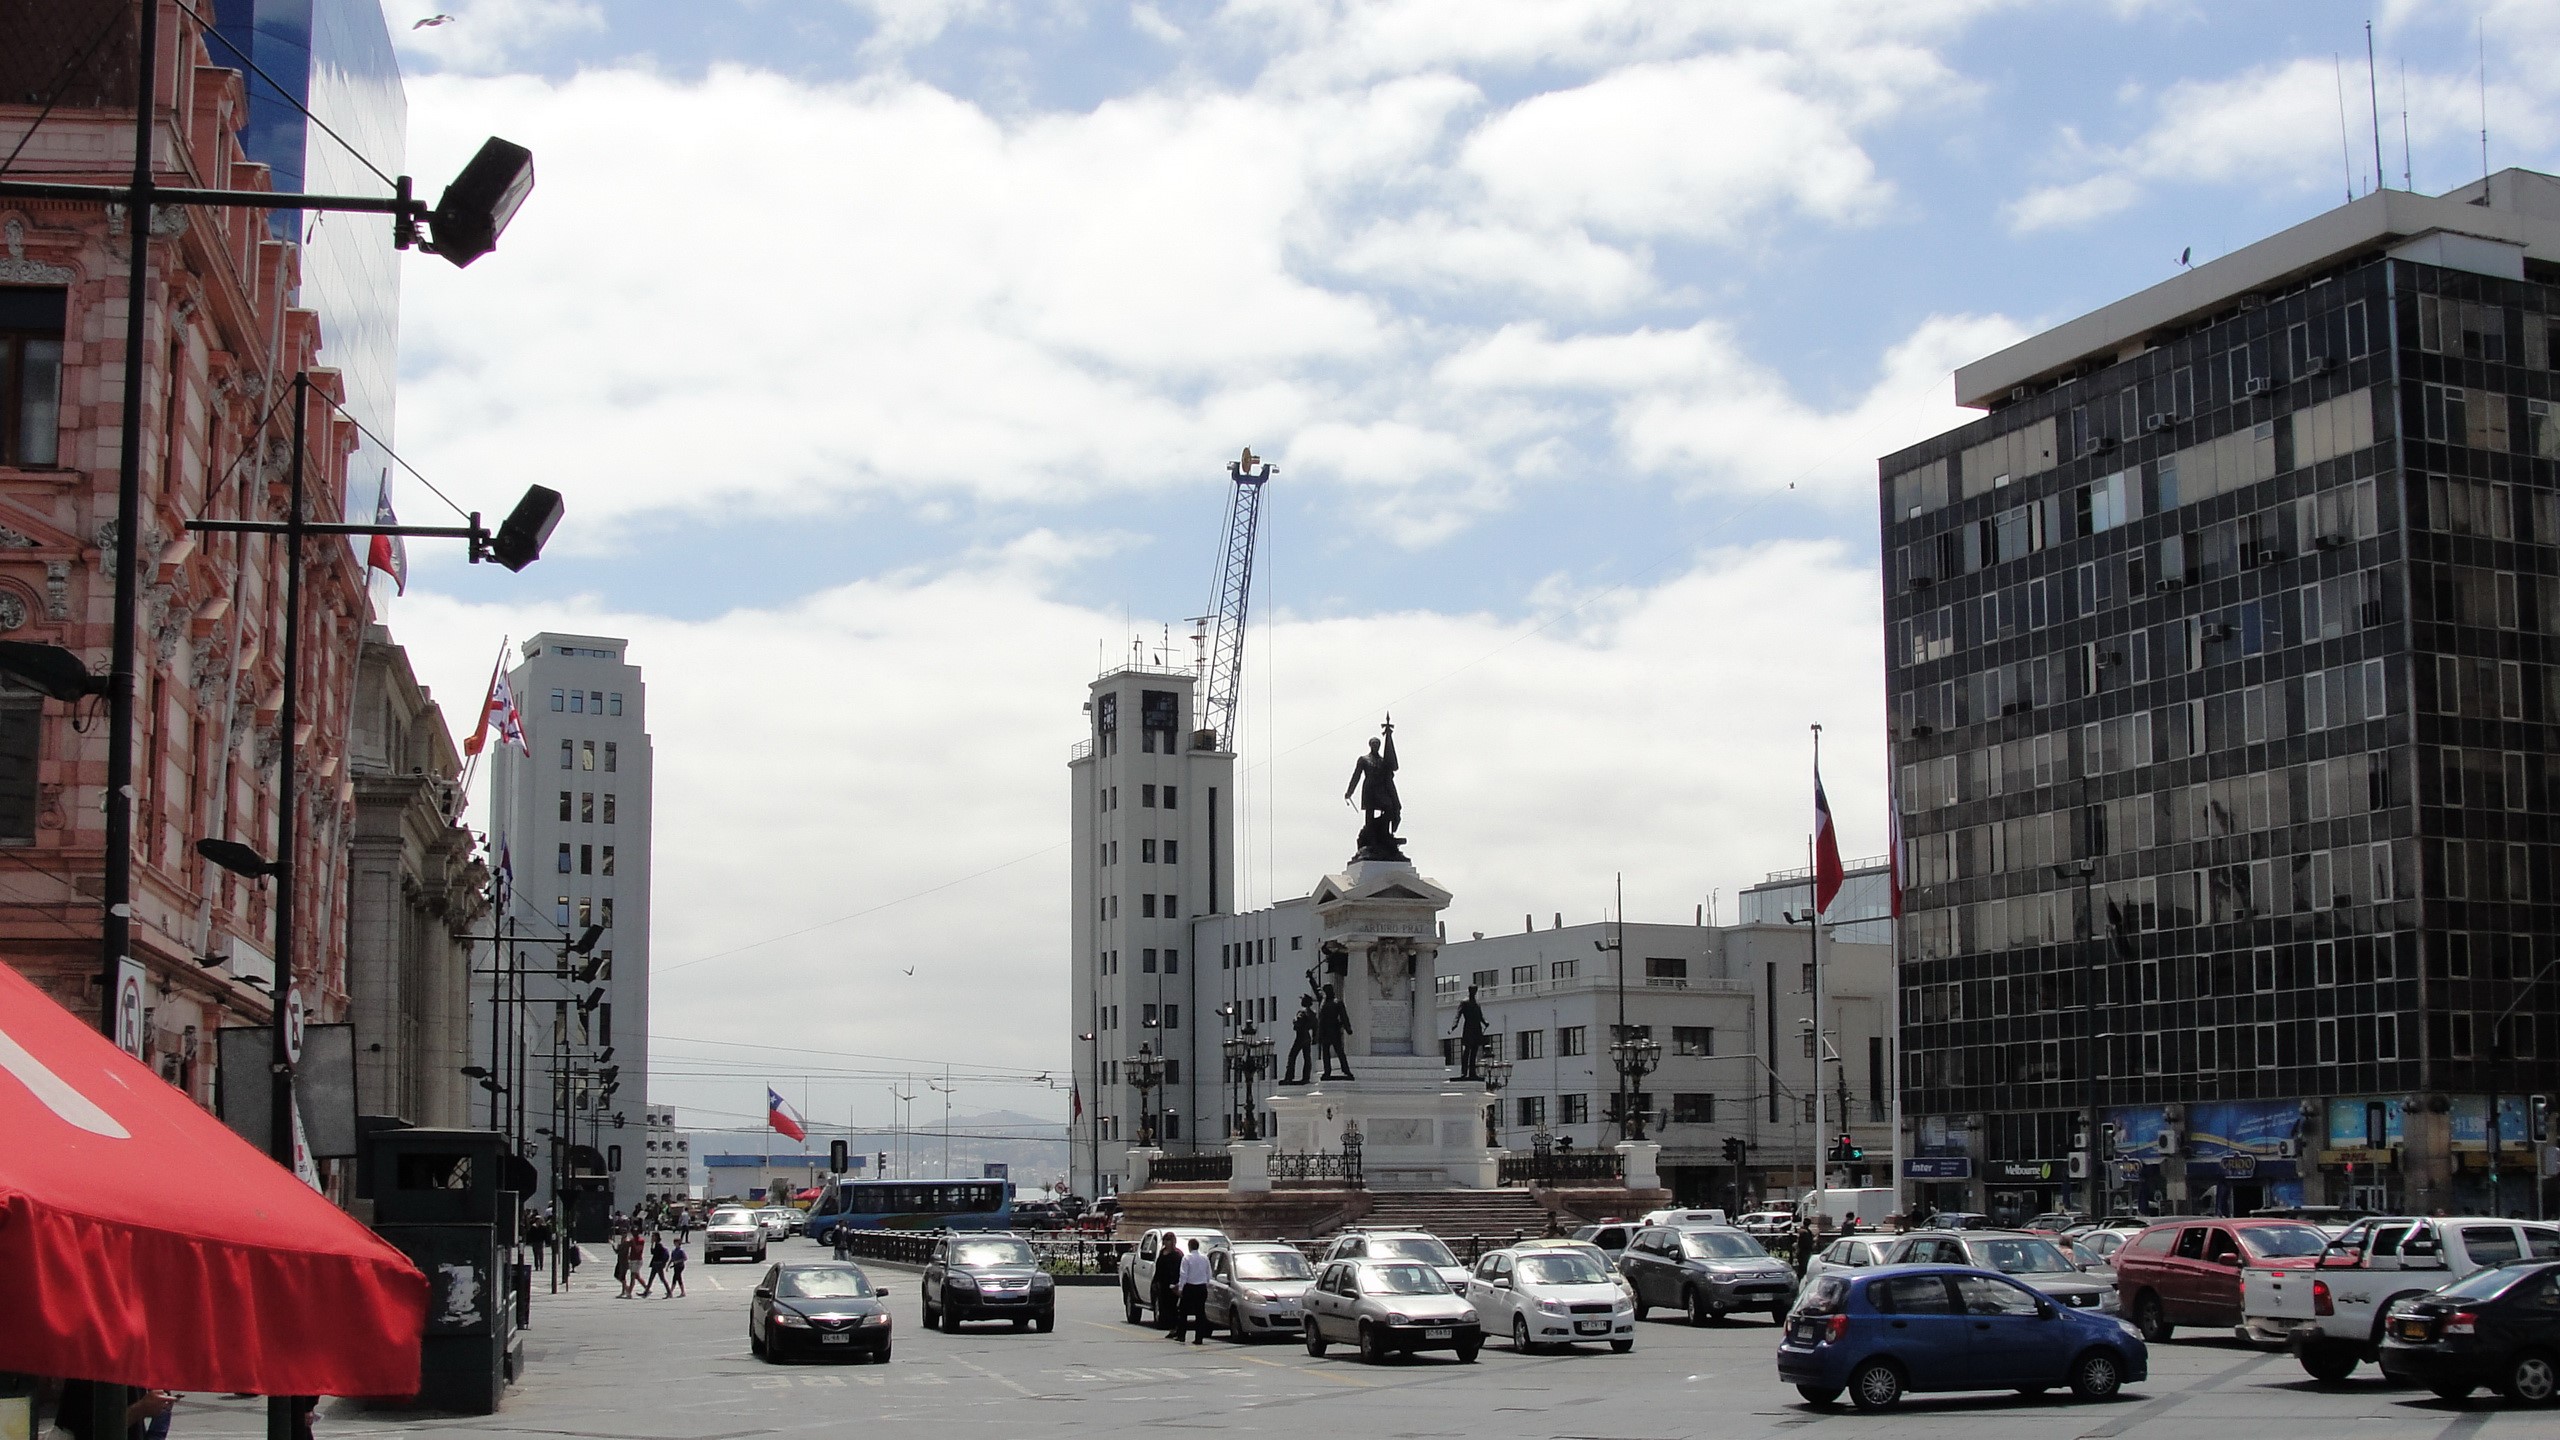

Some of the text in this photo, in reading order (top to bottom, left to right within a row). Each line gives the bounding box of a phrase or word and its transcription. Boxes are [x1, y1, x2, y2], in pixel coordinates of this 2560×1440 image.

[1364, 924, 1398, 933] ARTURO
[1911, 1161, 1933, 1172] inter
[2005, 1164, 2041, 1176] Melbourne
